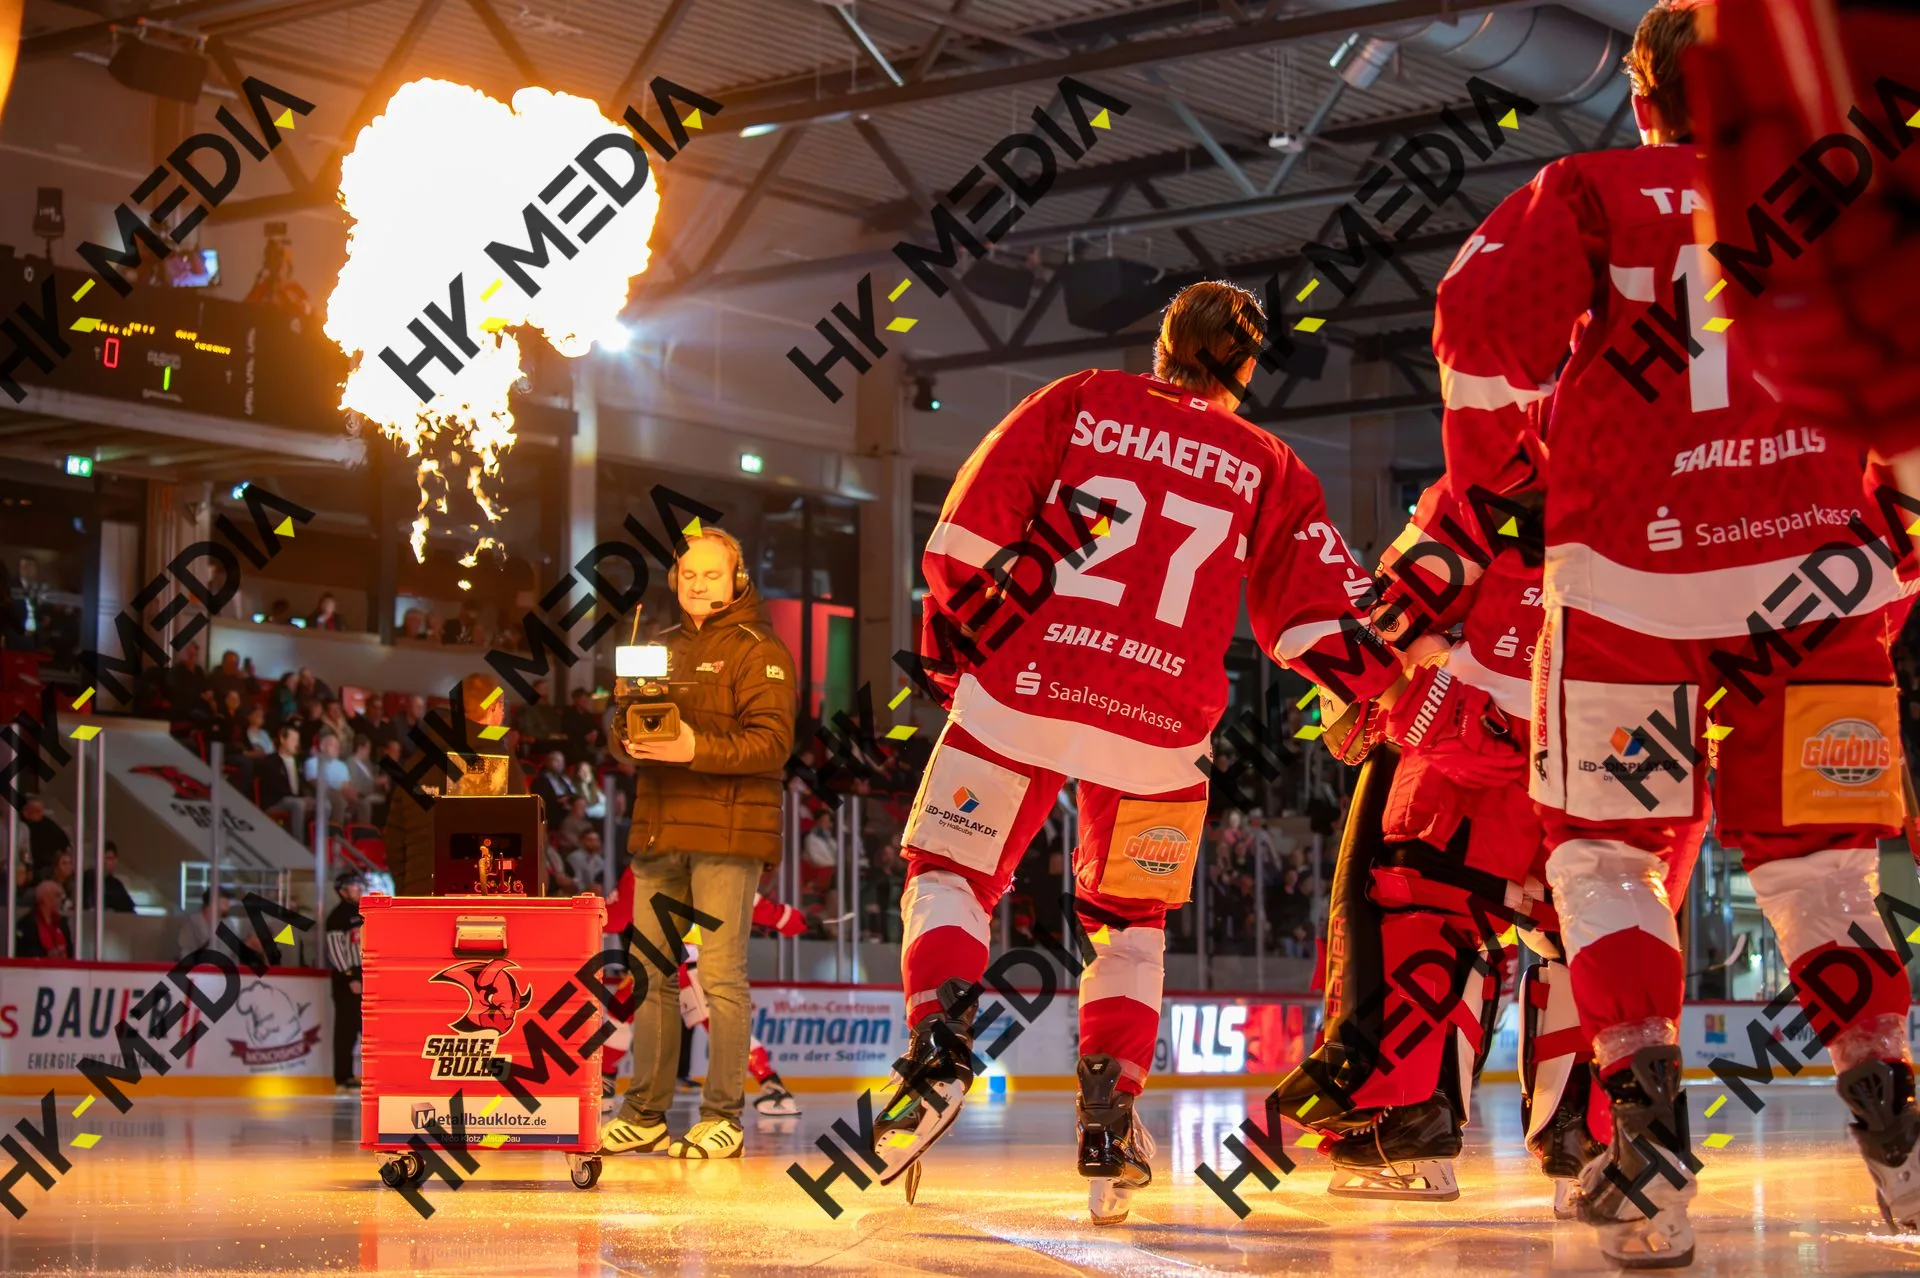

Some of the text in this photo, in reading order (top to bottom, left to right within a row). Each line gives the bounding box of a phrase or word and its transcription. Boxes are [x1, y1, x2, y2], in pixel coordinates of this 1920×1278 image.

[1071, 410, 1261, 504] SCHAEFER
[1671, 439, 1754, 476] SAALE
[1695, 504, 1861, 546] Saalesparkasse
[1054, 475, 1233, 628] 27
[1043, 623, 1186, 677] SAALE BULLS
[1047, 681, 1182, 733] Saalesparkasse
[1403, 669, 1452, 747] WARRIO
[925, 804, 998, 838] LED-DISPLAY.DE
[752, 1007, 892, 1044] hrmann
[28, 1053, 77, 1069] ENERGIE
[425, 1037, 495, 1057] SAALE
[437, 1057, 506, 1077] BULLS
